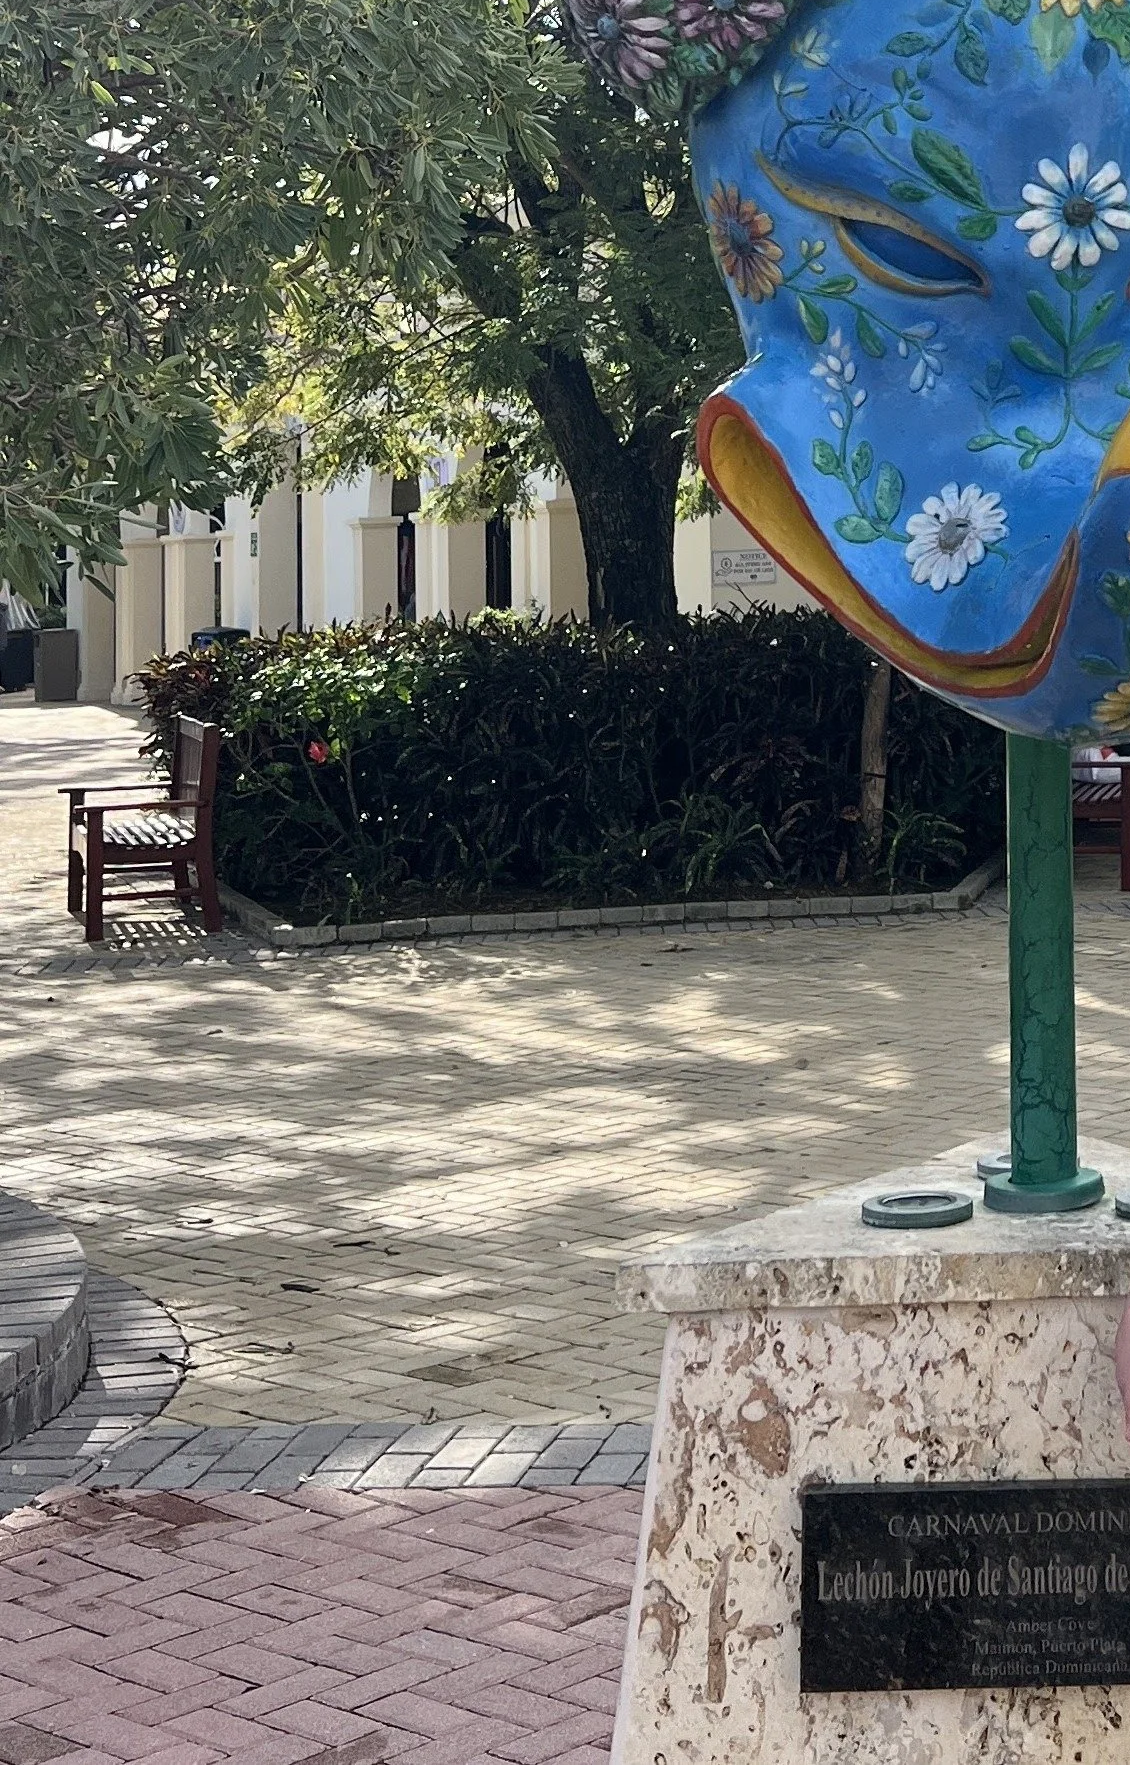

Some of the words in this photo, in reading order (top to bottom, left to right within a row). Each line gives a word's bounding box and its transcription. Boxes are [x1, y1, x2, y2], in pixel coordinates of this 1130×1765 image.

[887, 1512, 1030, 1538] CARNAVAL
[817, 1557, 894, 1602] Lechón
[900, 1557, 971, 1611] Joyero
[977, 1555, 1003, 1597] de
[1007, 1553, 1098, 1606] Santiago
[1104, 1552, 1129, 1594] de
[1005, 1619, 1052, 1634] Amber
[1057, 1616, 1098, 1632] Cove
